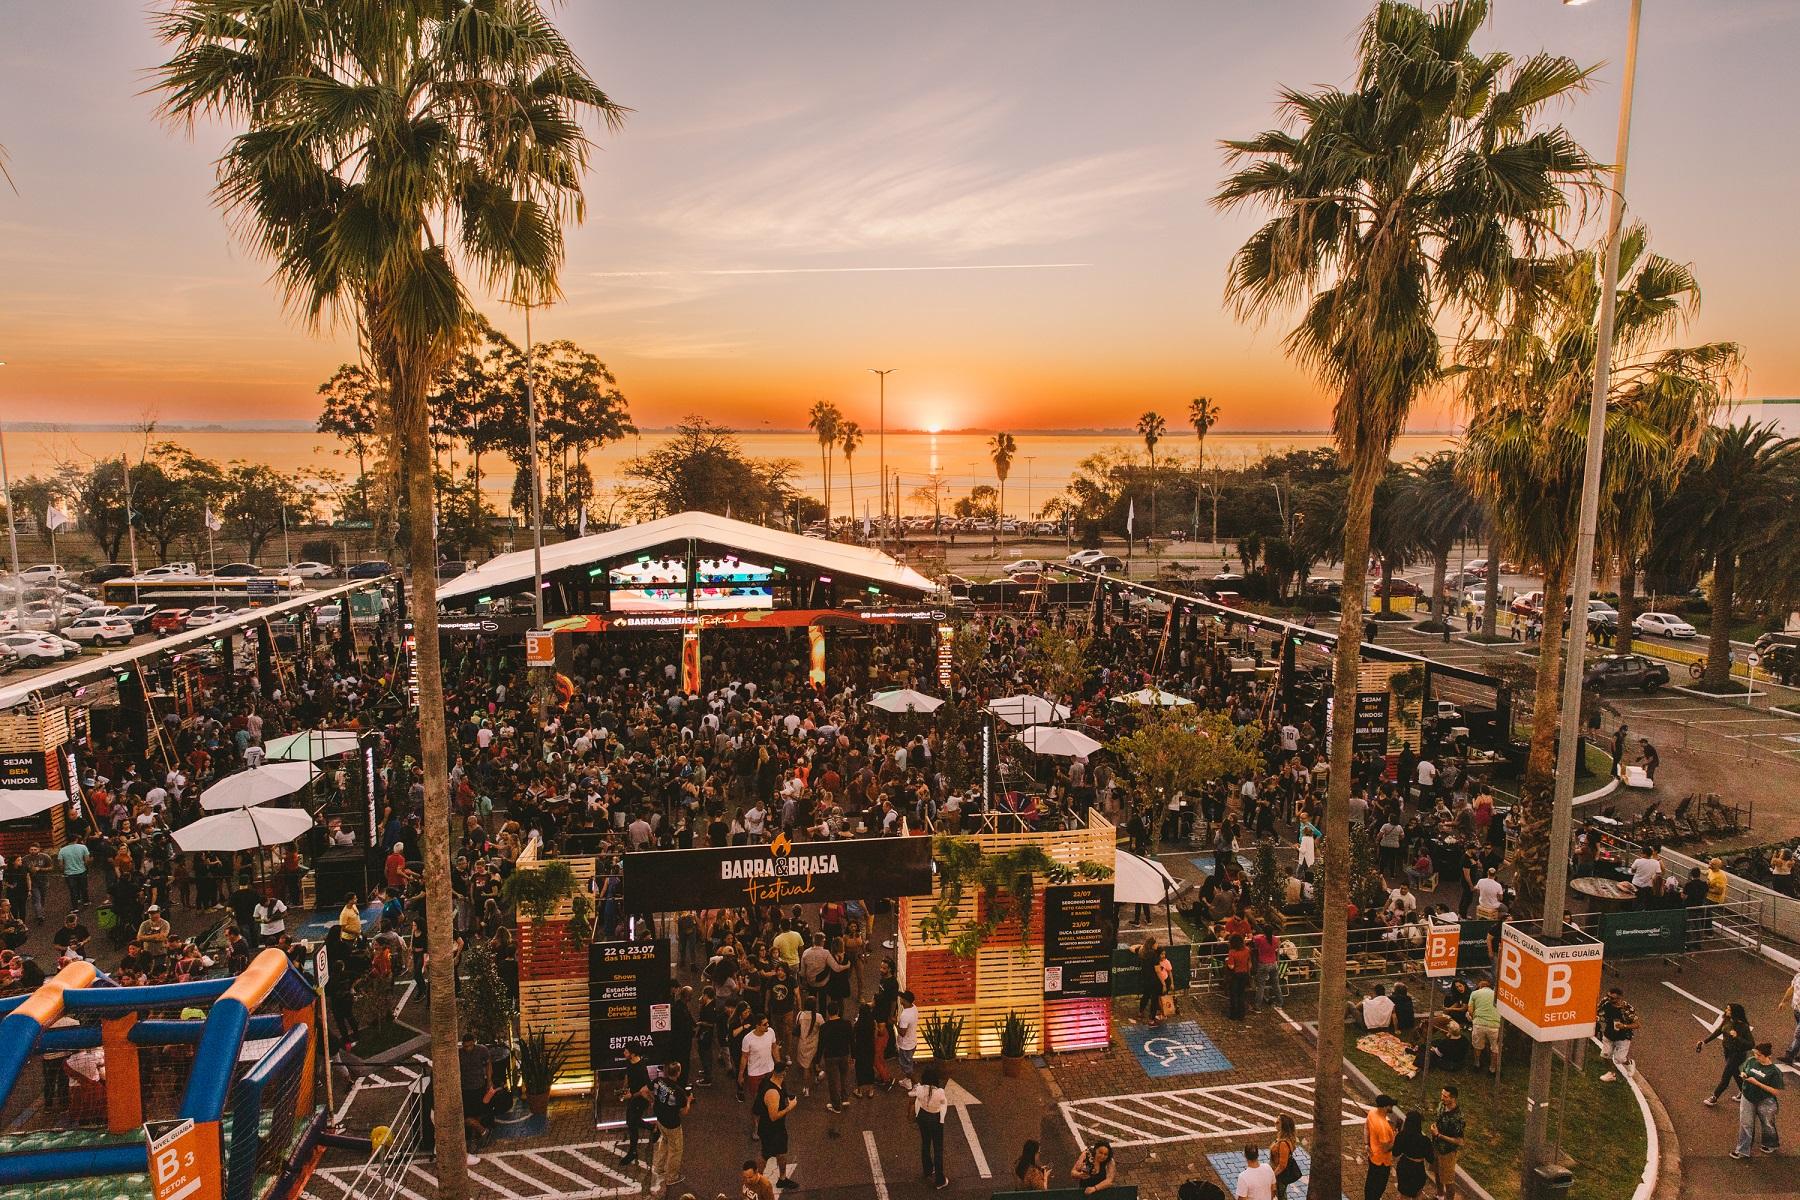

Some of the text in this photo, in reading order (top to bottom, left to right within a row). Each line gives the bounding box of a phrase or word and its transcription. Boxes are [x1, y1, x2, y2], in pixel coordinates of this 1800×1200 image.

[627, 616, 698, 626] BARRA&BRASA
[527, 638, 539, 654] B
[3, 758, 33, 766] SEJAM
[1, 777, 38, 785] VINDOS!
[721, 854, 839, 880] BARRA&BRASA
[742, 869, 815, 905] Festival
[604, 948, 617, 956] 22
[627, 945, 655, 954] 23.07
[1431, 937, 1456, 958] B 2
[1503, 929, 1544, 957] NÍVEL GUAÍBA
[1549, 949, 1600, 959] NÍVEL GUAÍBA
[1500, 942, 1522, 989] B
[605, 986, 637, 994] Estações
[1544, 963, 1572, 1007] B
[1499, 987, 1525, 1010] SETOR
[608, 1005, 631, 1013] Drinks
[1544, 1010, 1576, 1022] SETOR
[610, 1034, 653, 1043] ENTRADA
[170, 1123, 193, 1140] GUAÍBA
[156, 1148, 195, 1185] B 3
[160, 1175, 187, 1197] SETOR
